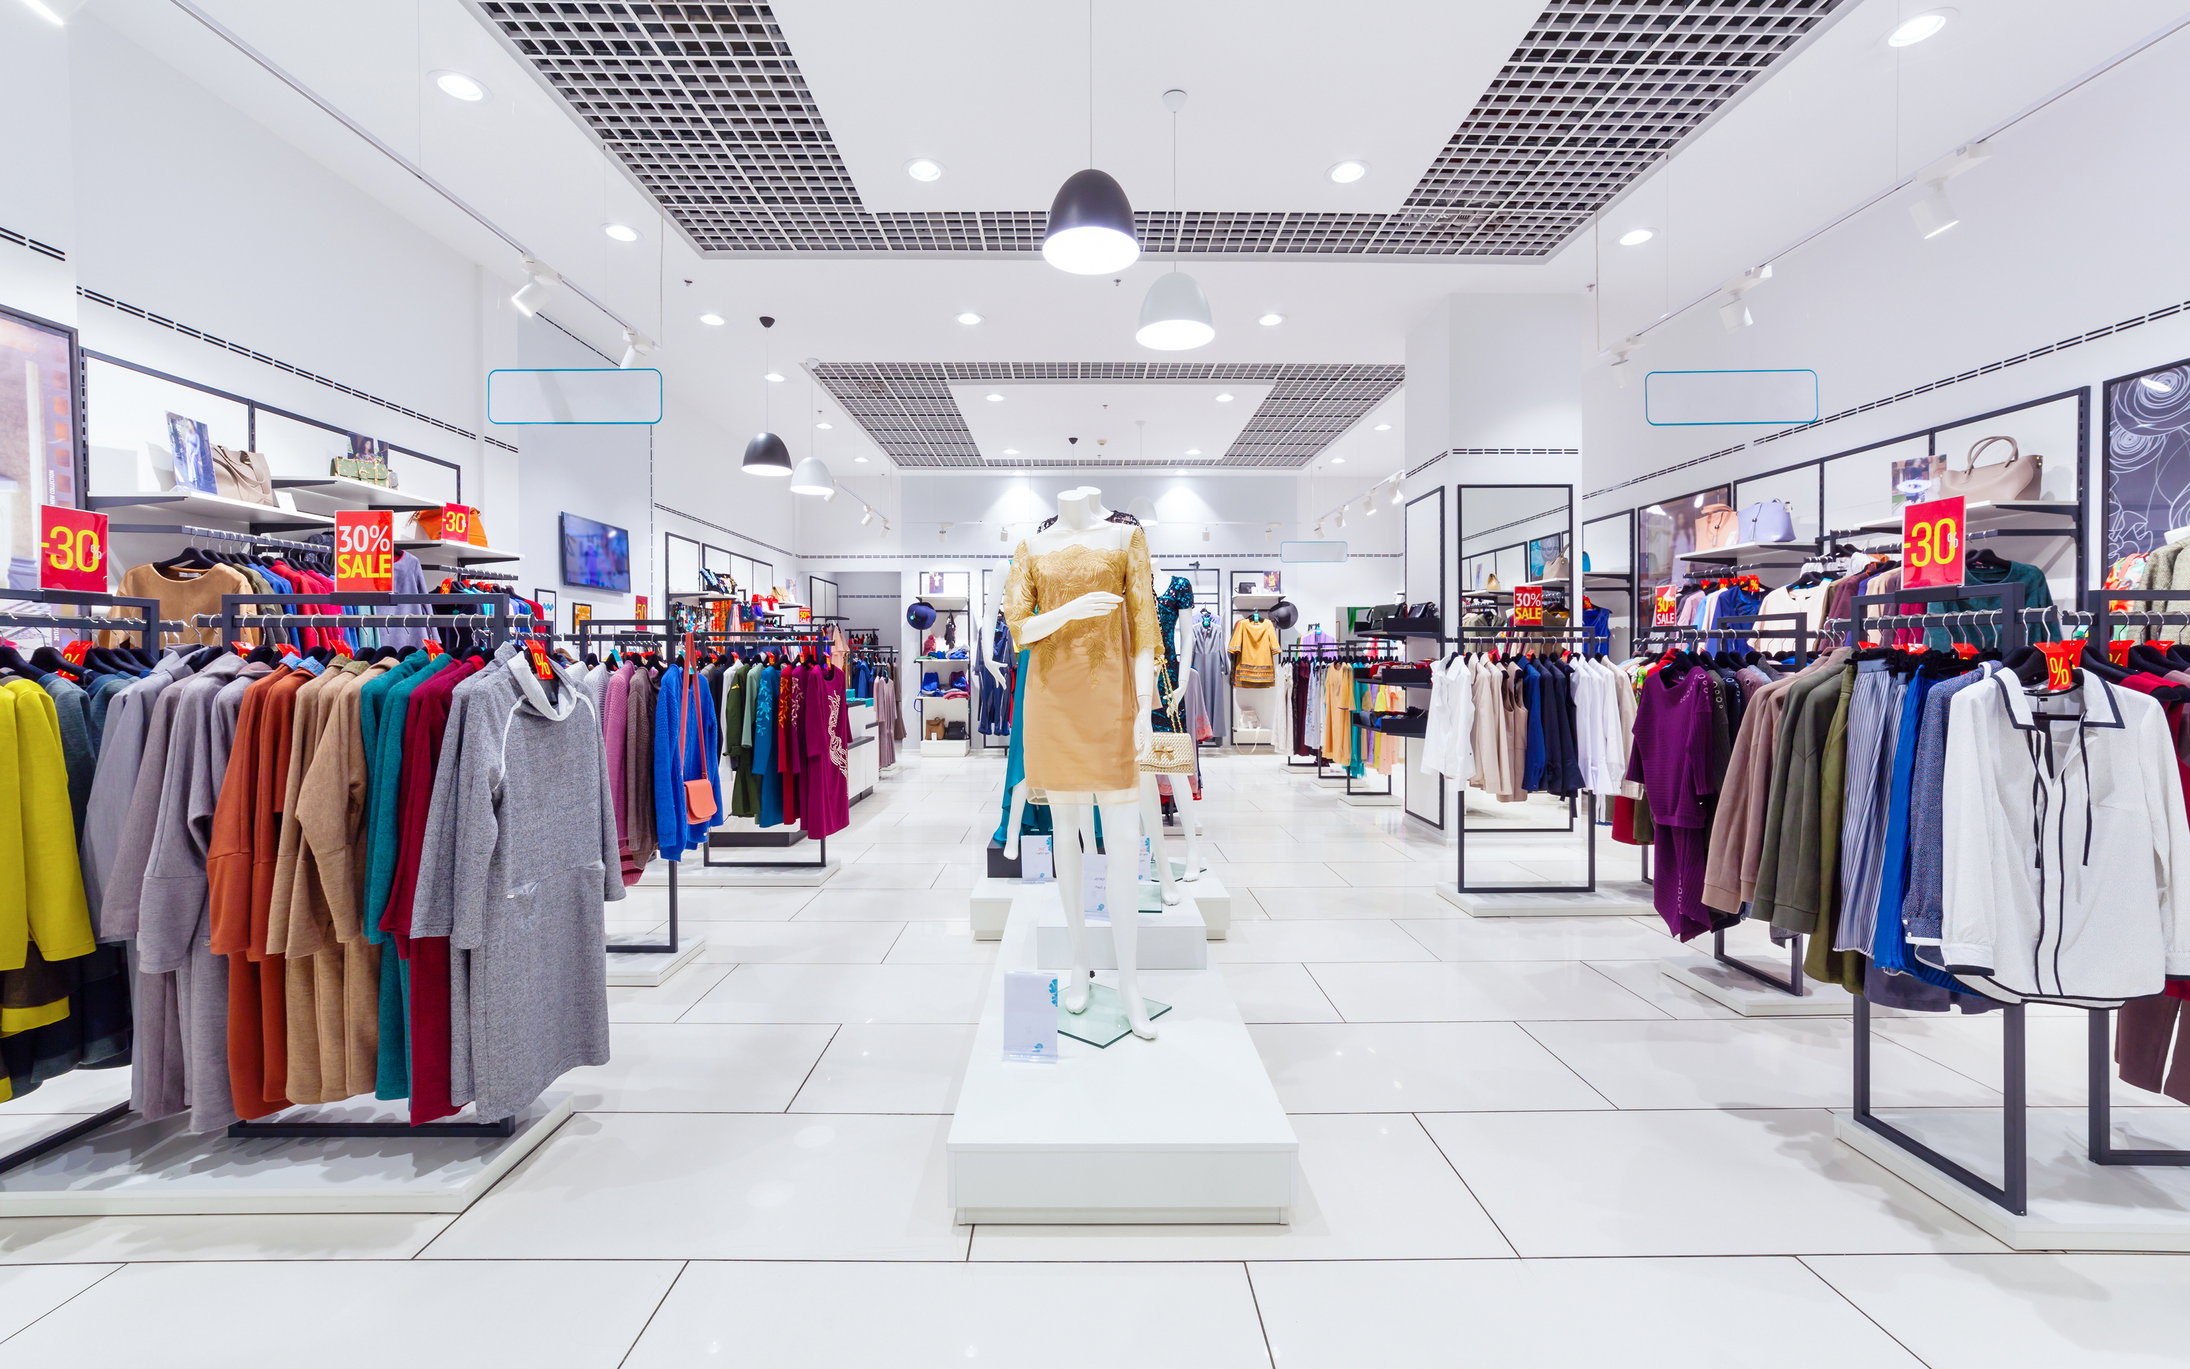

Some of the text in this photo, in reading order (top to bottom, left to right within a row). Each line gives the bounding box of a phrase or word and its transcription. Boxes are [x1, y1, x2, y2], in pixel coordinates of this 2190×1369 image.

[338, 525, 390, 552] 30%
[337, 554, 392, 578] SALE
[1515, 593, 1541, 607] 30%
[1515, 607, 1542, 620] SALE
[1657, 612, 1675, 625] SALE
[534, 652, 551, 676] %
[2049, 657, 2070, 686] %
